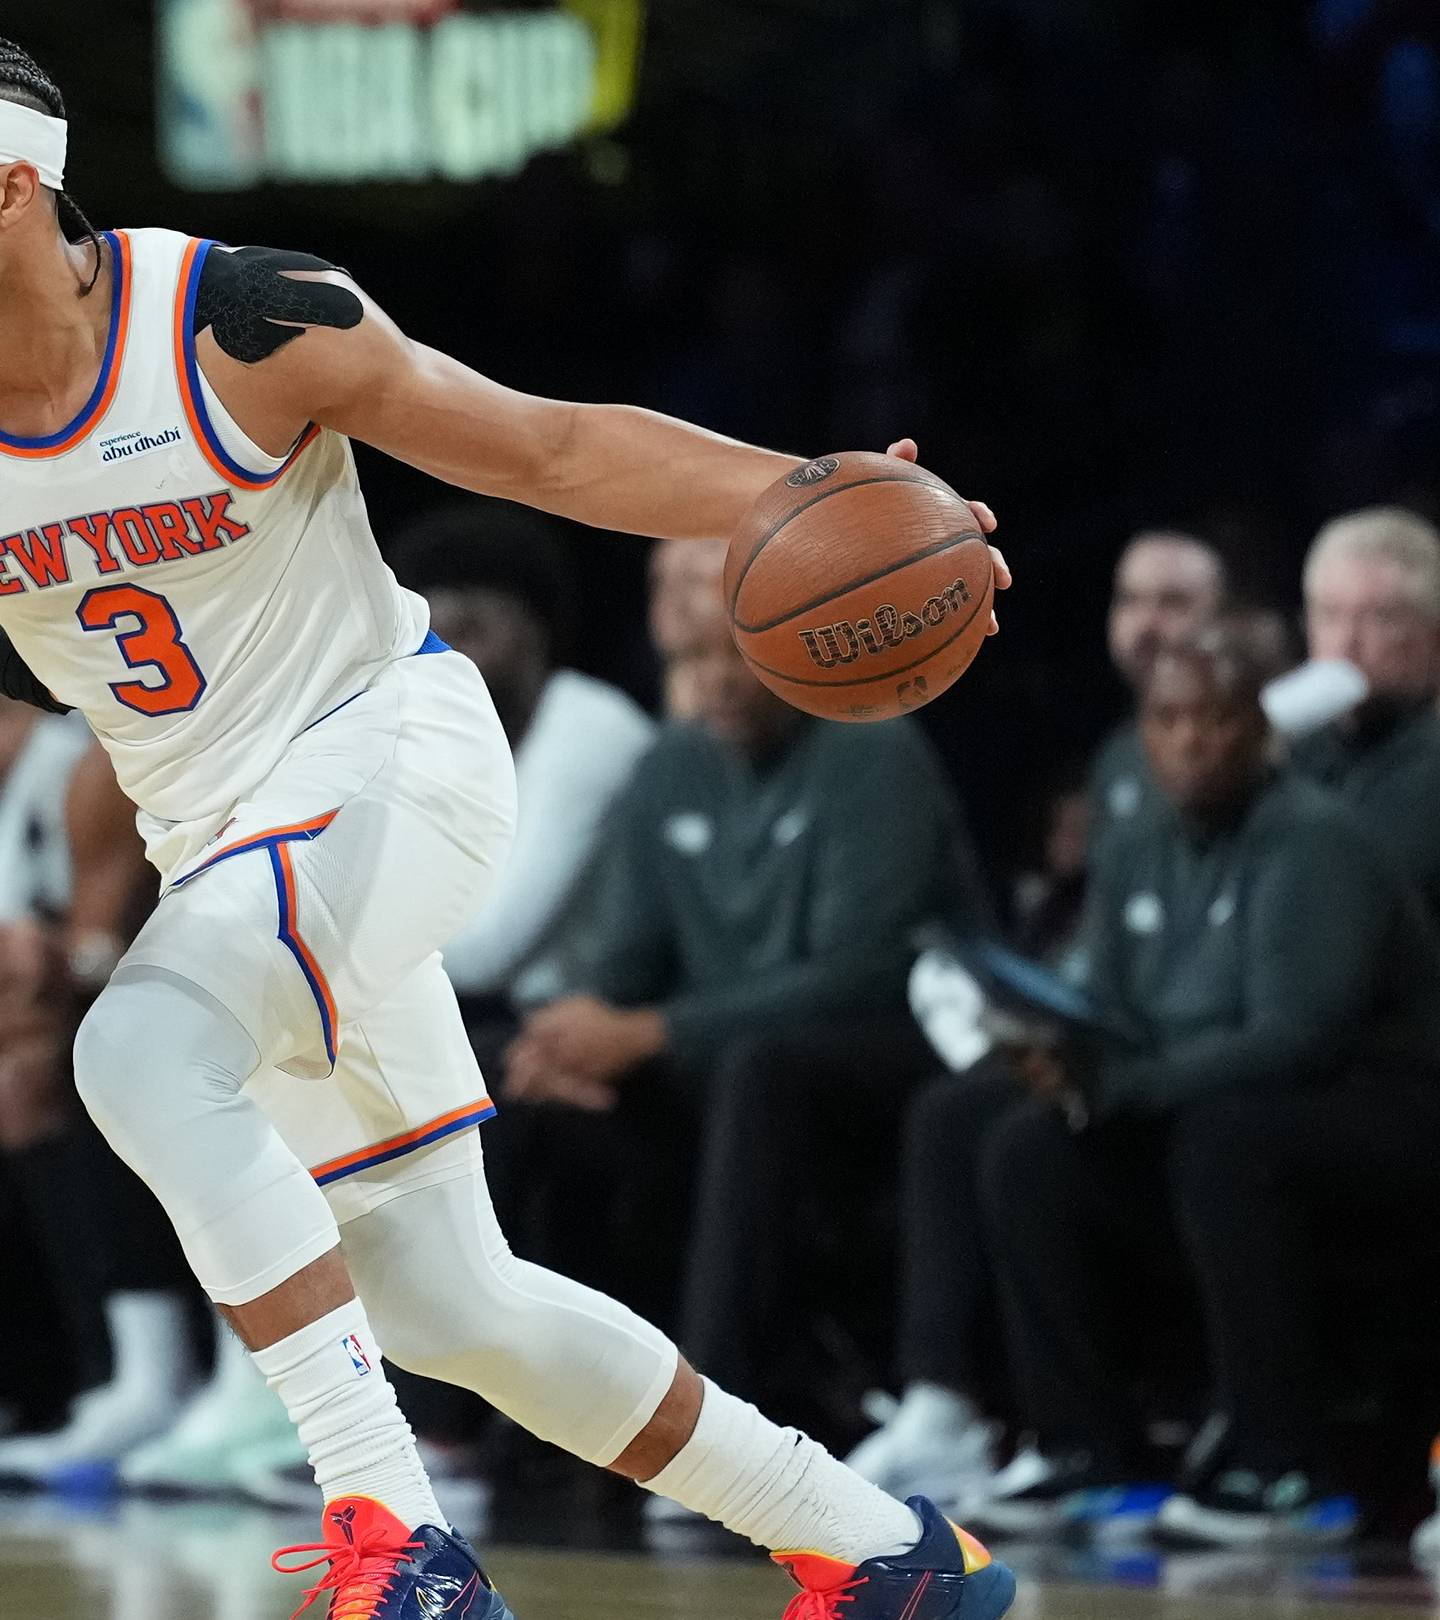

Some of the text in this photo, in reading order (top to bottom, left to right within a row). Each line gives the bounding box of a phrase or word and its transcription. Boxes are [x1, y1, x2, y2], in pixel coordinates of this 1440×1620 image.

[99, 431, 141, 447] experience
[102, 446, 133, 462] abu
[68, 488, 250, 576] YORK
[76, 582, 208, 717] 3
[798, 577, 972, 669] Wilson
